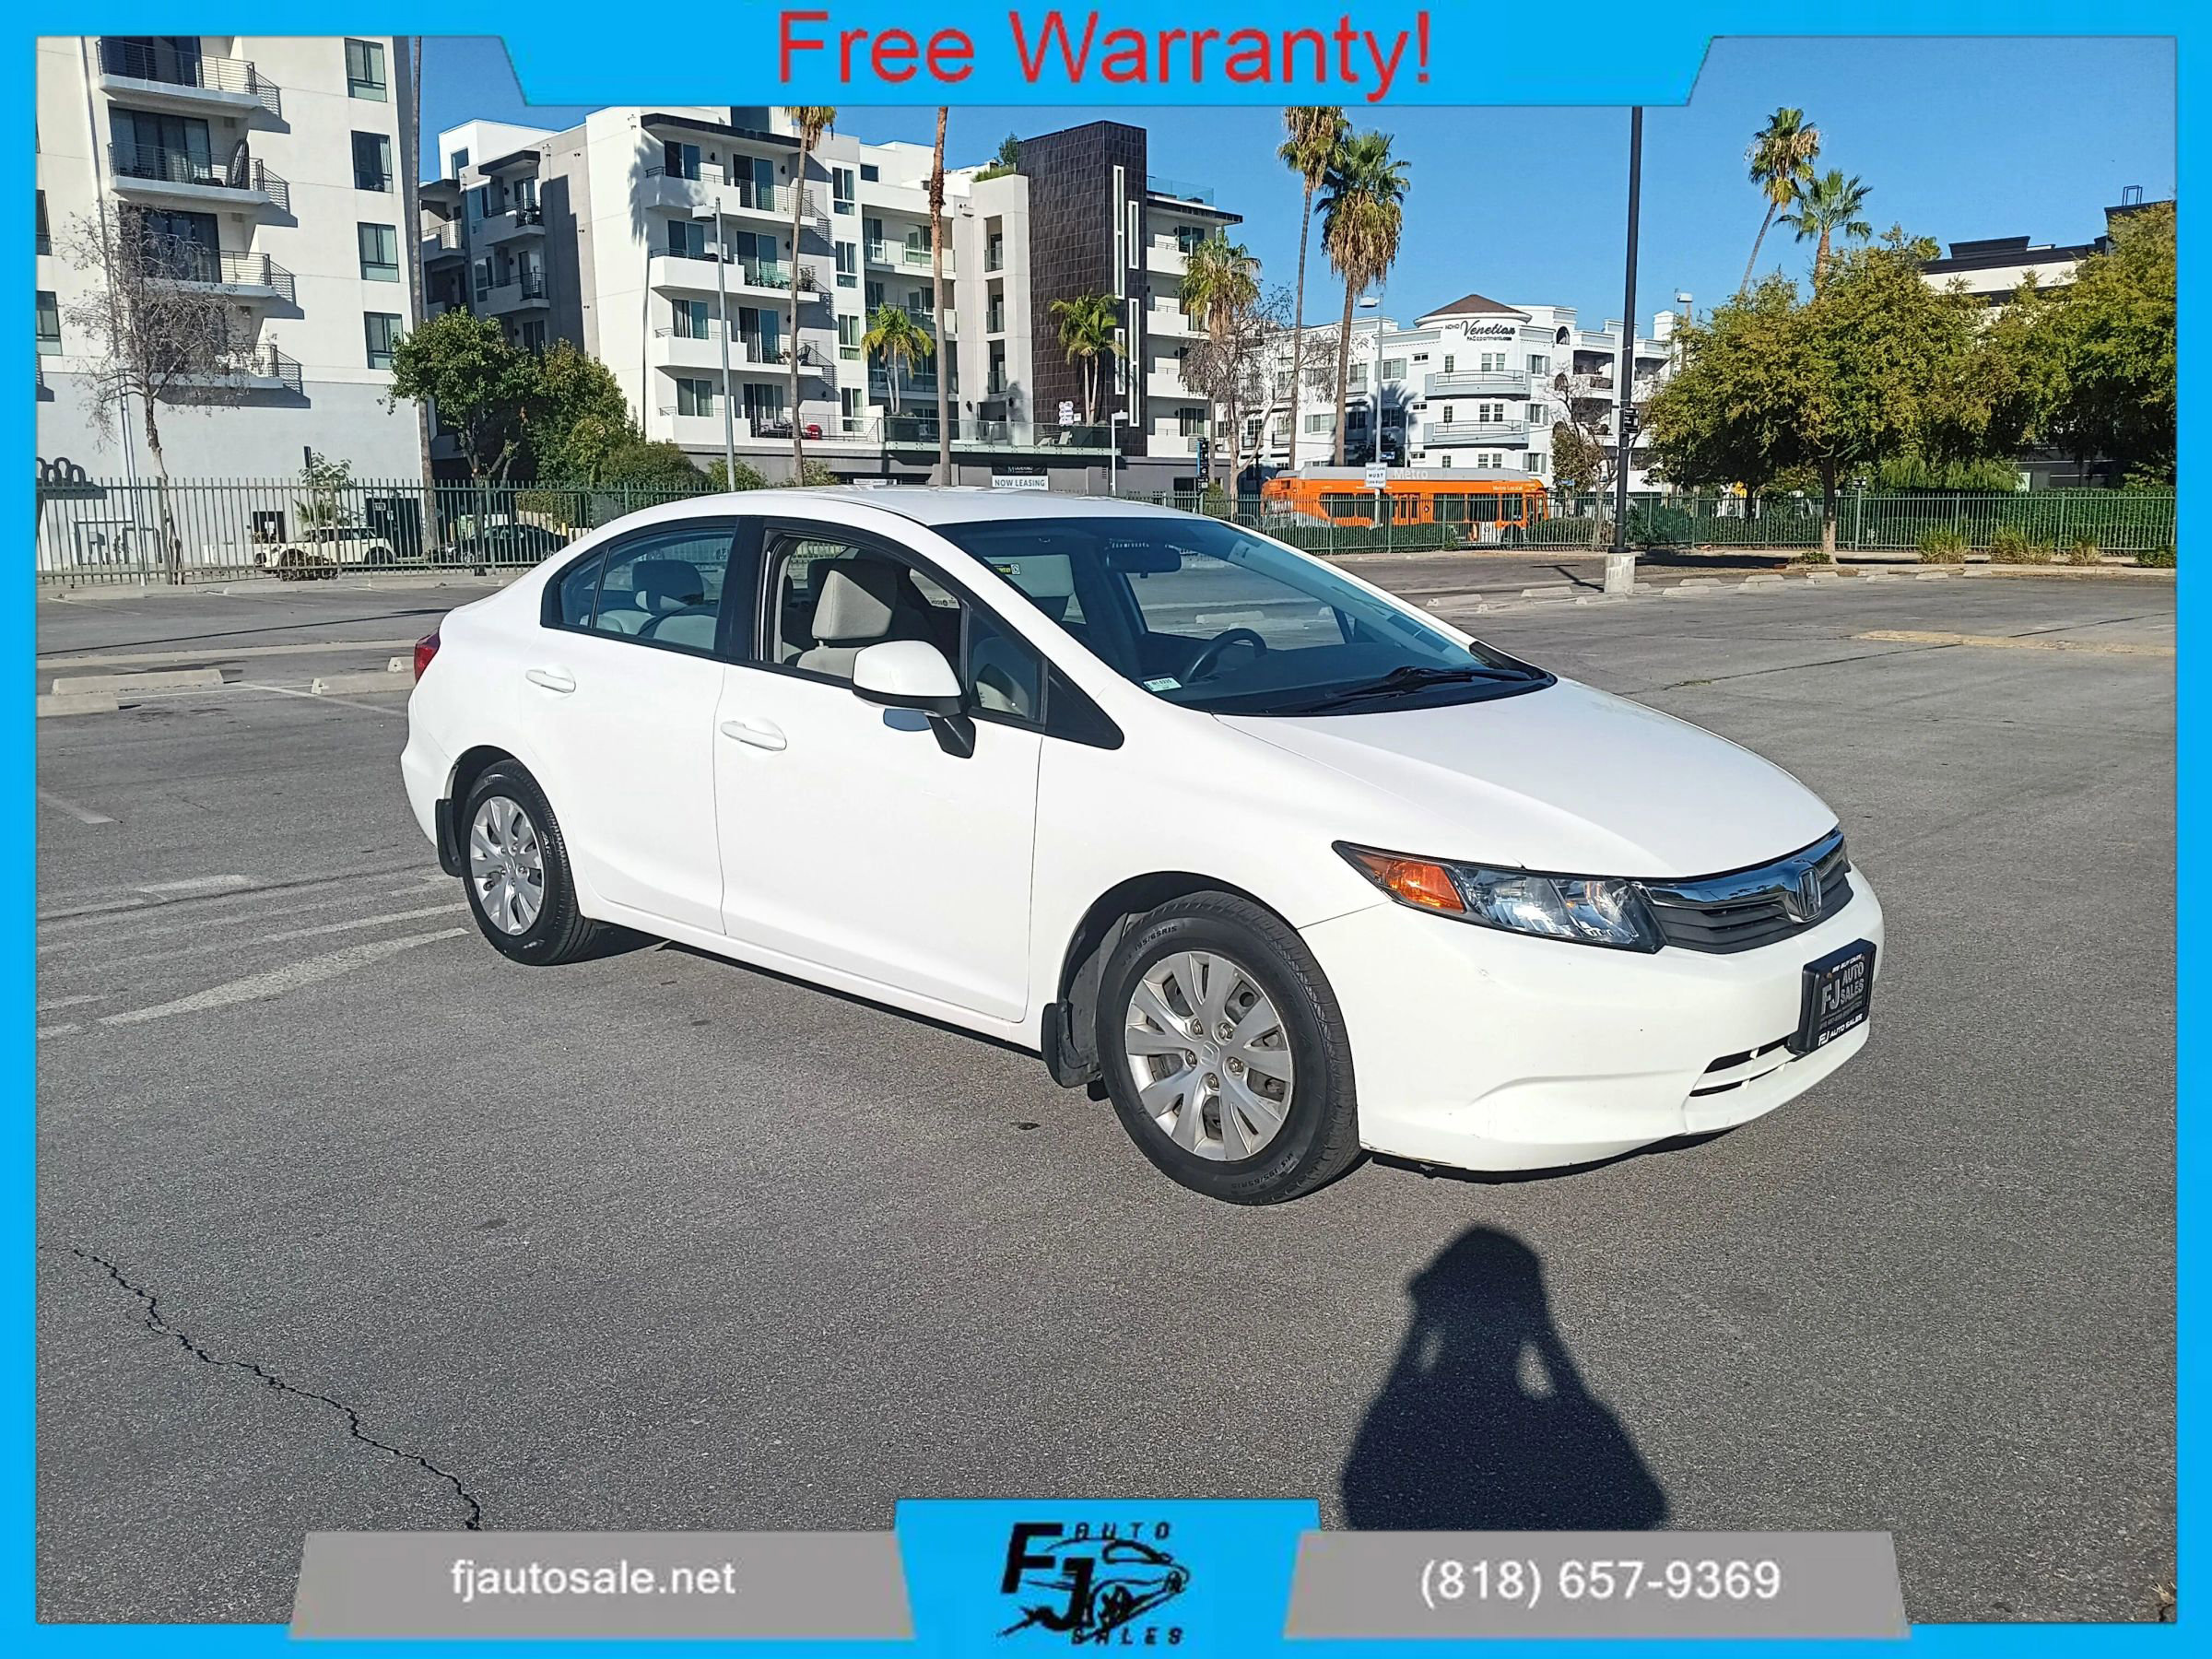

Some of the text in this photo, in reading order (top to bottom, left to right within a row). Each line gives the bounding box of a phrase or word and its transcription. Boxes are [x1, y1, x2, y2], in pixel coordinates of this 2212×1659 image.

[1460, 320, 1515, 336] Venetian
[1393, 468, 1429, 479] Metro
[1842, 961, 1865, 987] AUTO
[1820, 978, 1841, 1016] FJ
[1840, 978, 1865, 1005] SALES
[1818, 1030, 1830, 1047] FJ
[1830, 1024, 1845, 1039] AUTO
[1845, 1013, 1864, 1030] SALES
